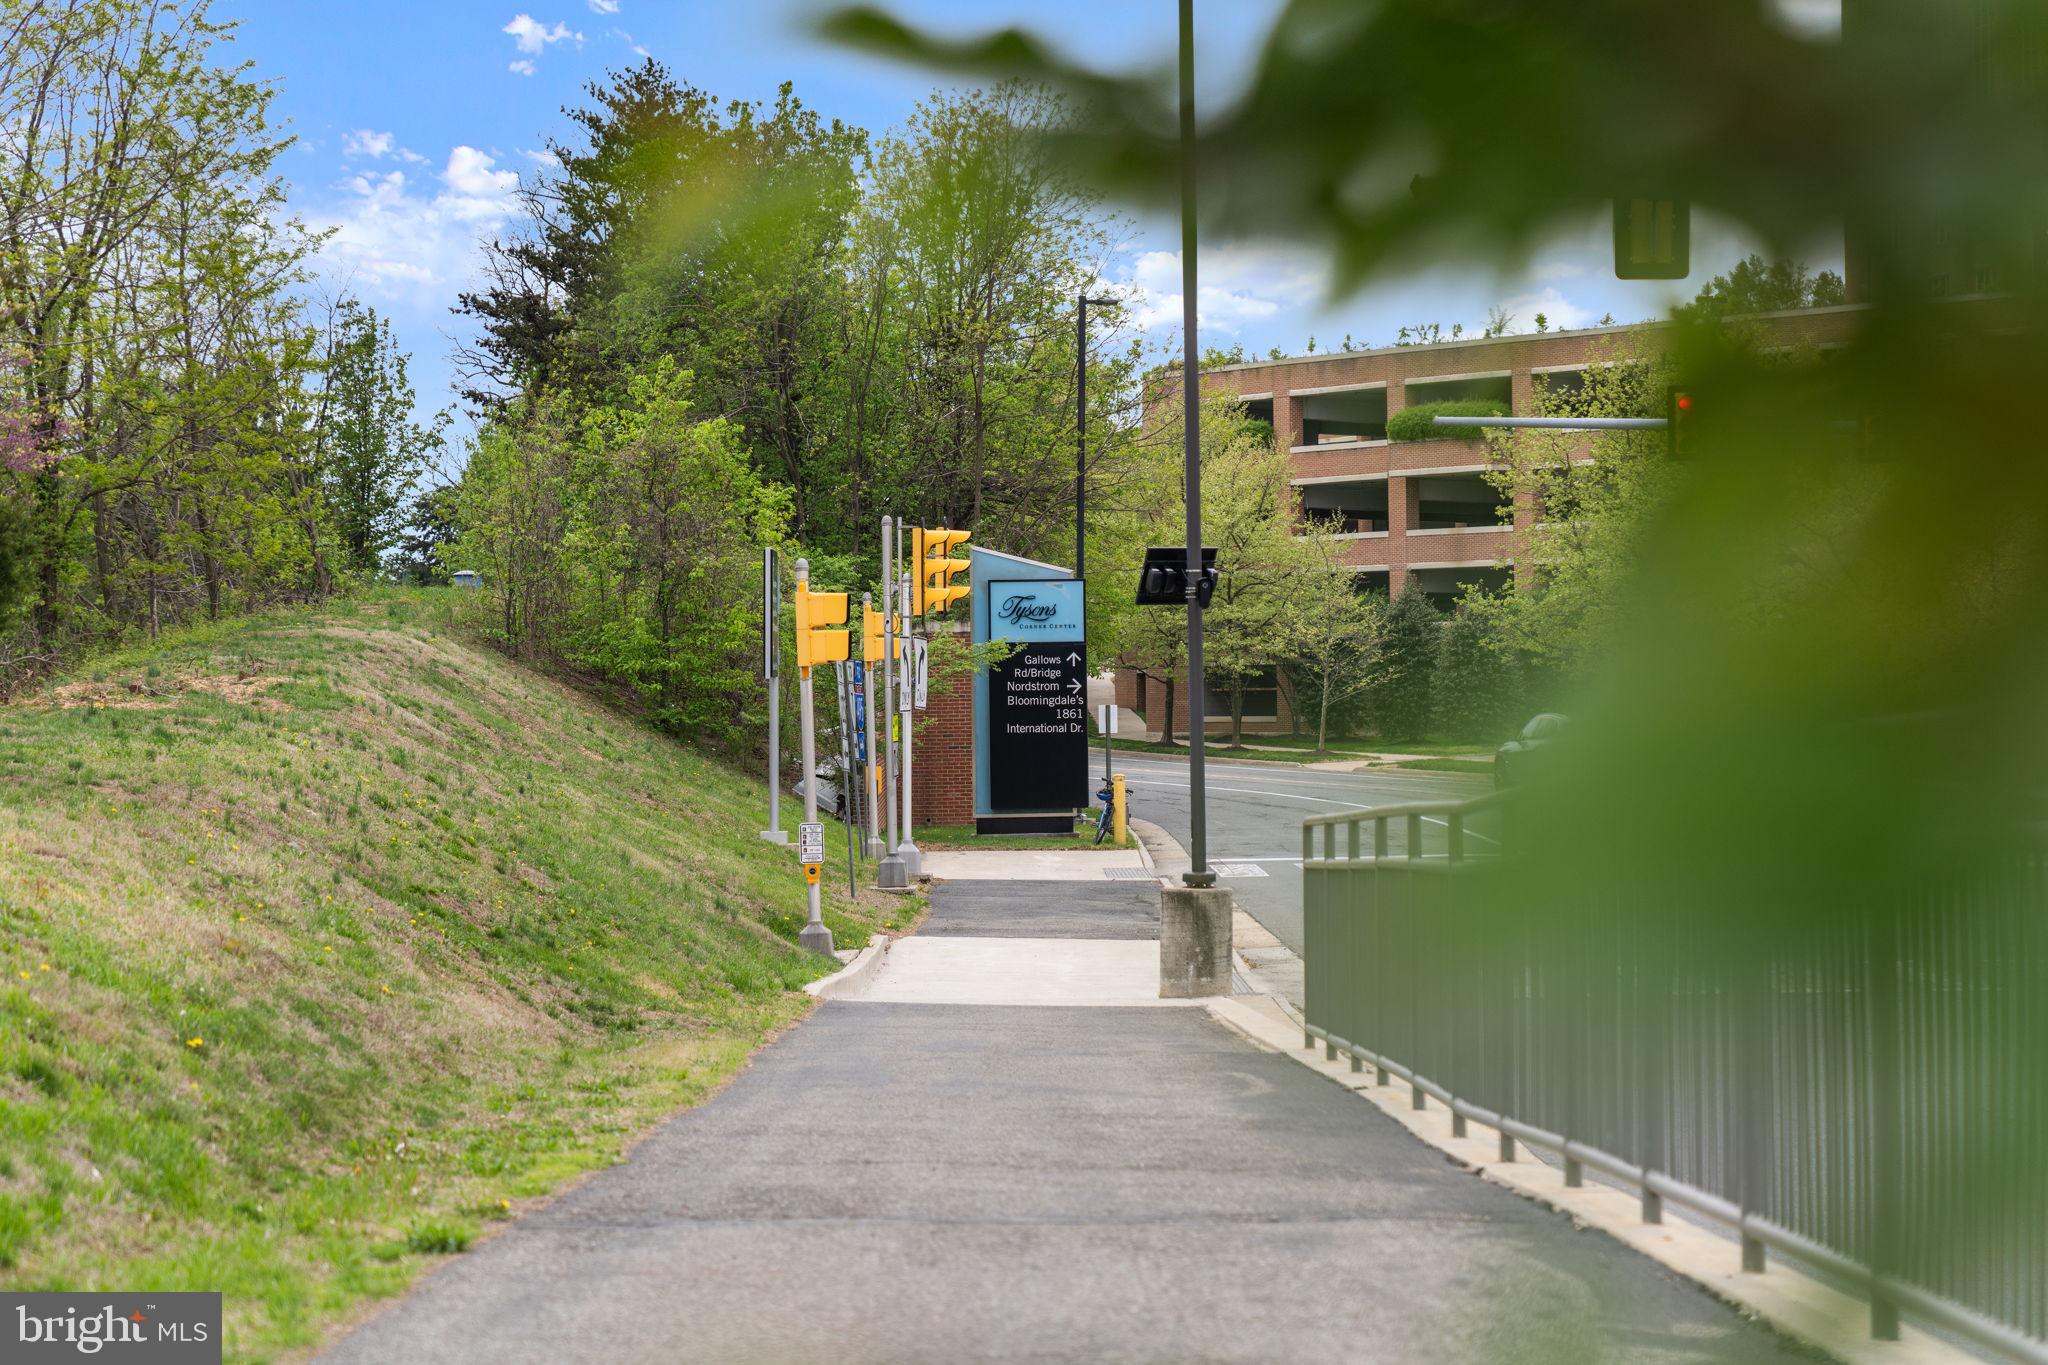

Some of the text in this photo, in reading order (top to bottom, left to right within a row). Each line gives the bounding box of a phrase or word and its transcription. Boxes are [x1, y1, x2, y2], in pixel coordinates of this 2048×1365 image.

[998, 595, 1057, 625] Tysons
[1024, 655, 1062, 665] Gallows
[1014, 668, 1062, 679] Rd/Bridge
[1007, 681, 1060, 691] Nordstrom
[1007, 695, 1084, 707] Bloomingdale's
[1056, 708, 1083, 719] 1861
[1006, 723, 1084, 733] International Dr.
